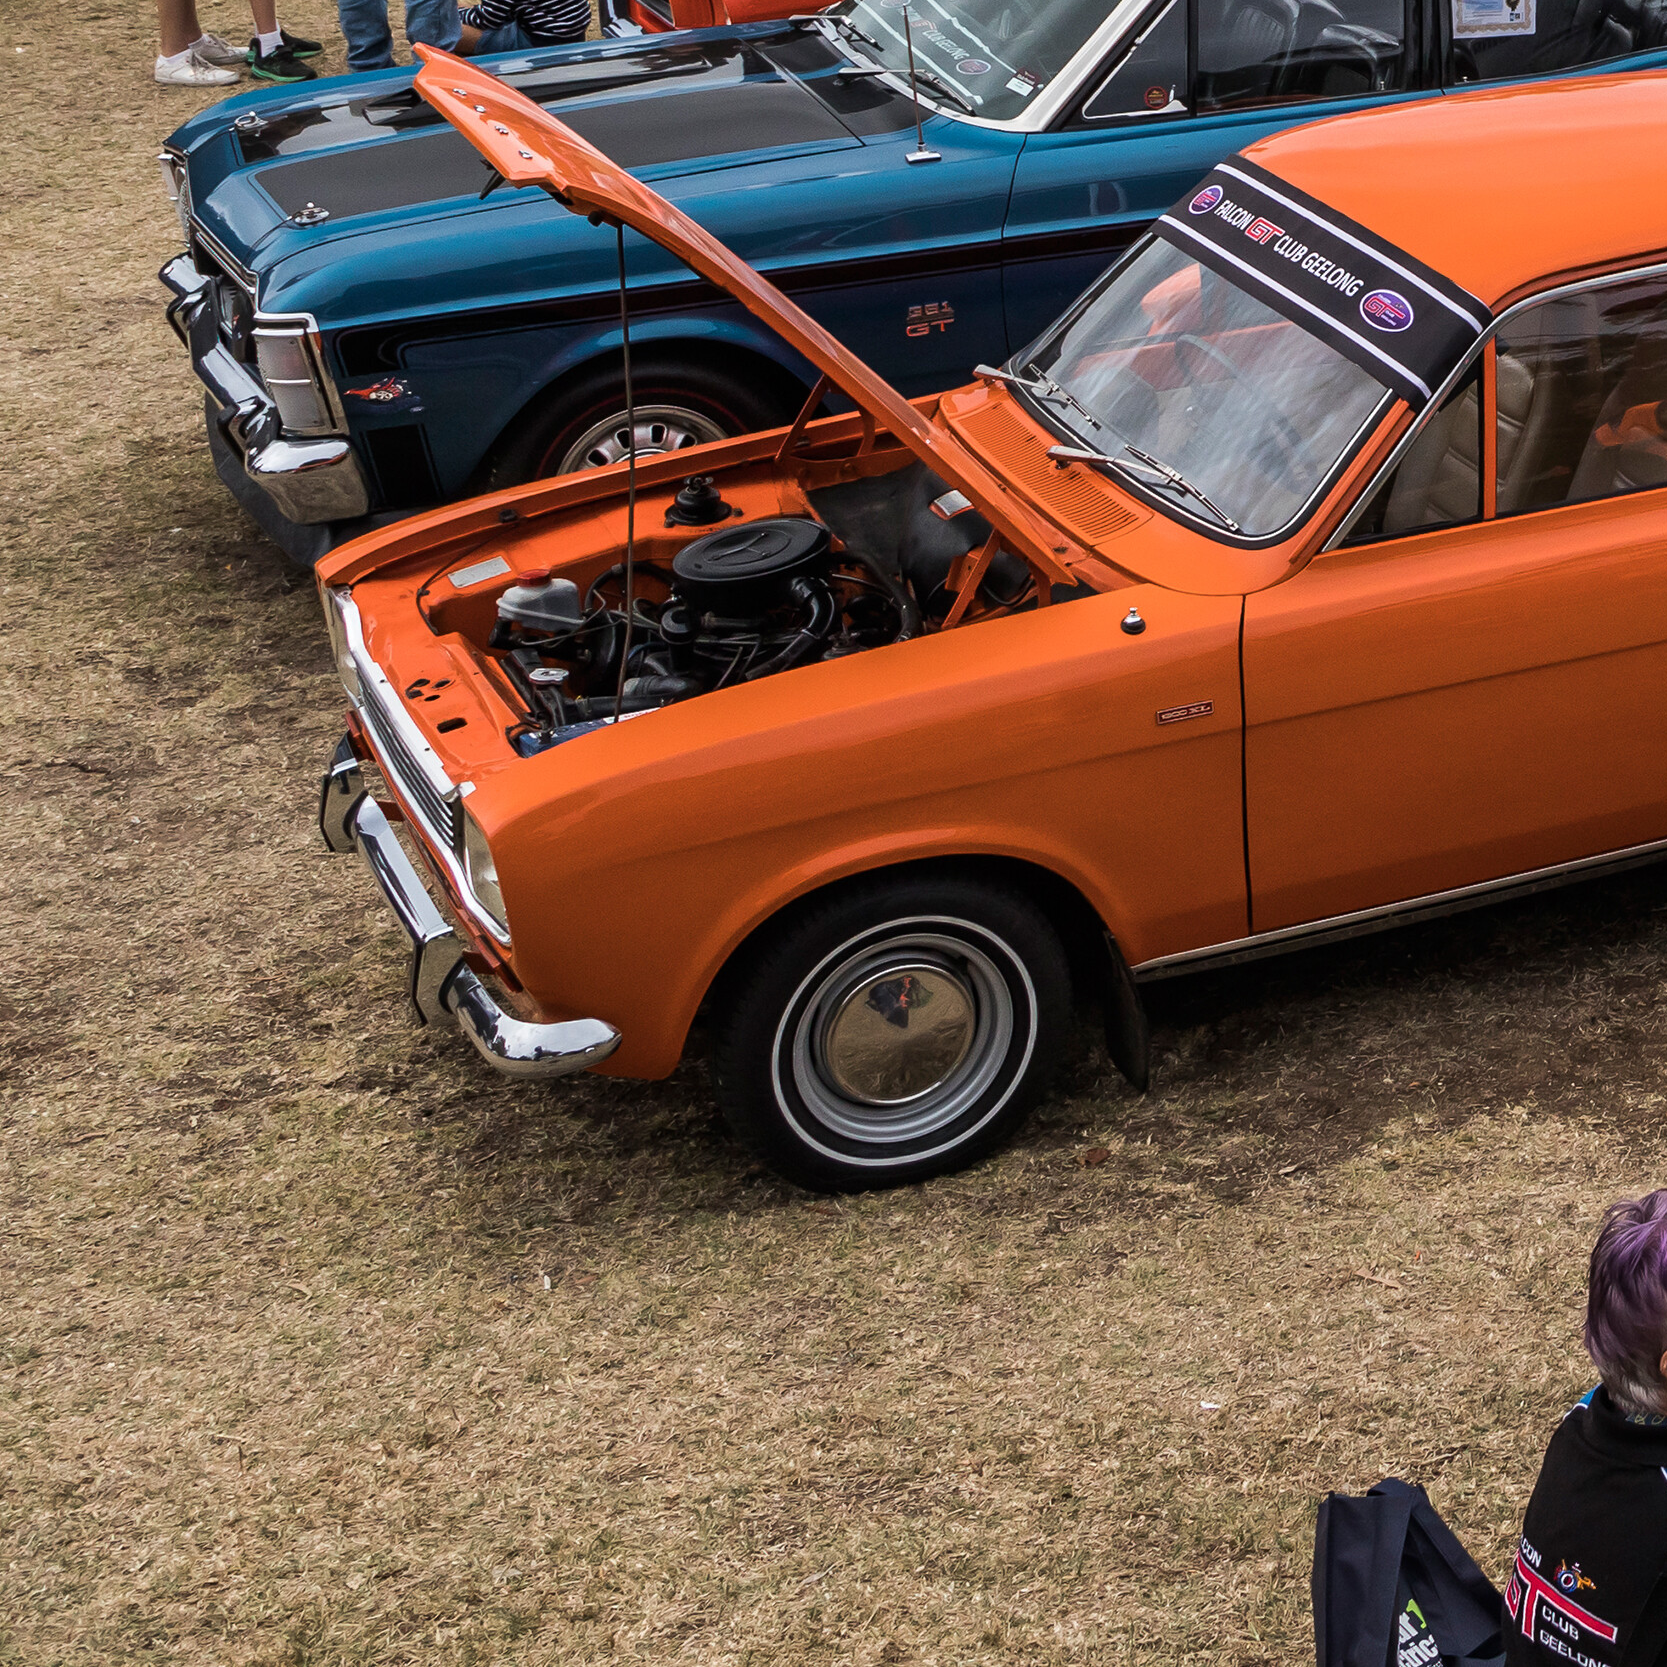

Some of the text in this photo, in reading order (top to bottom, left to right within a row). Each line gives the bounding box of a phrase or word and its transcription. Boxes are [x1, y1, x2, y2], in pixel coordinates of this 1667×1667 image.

[1213, 199, 1365, 298] FALCON GT CLUB GEELONG
[1363, 296, 1406, 322] GT
[905, 318, 955, 337] GT
[1188, 705, 1211, 715] XL
[1520, 1537, 1542, 1568] CON
[1542, 1604, 1580, 1641] CLUB
